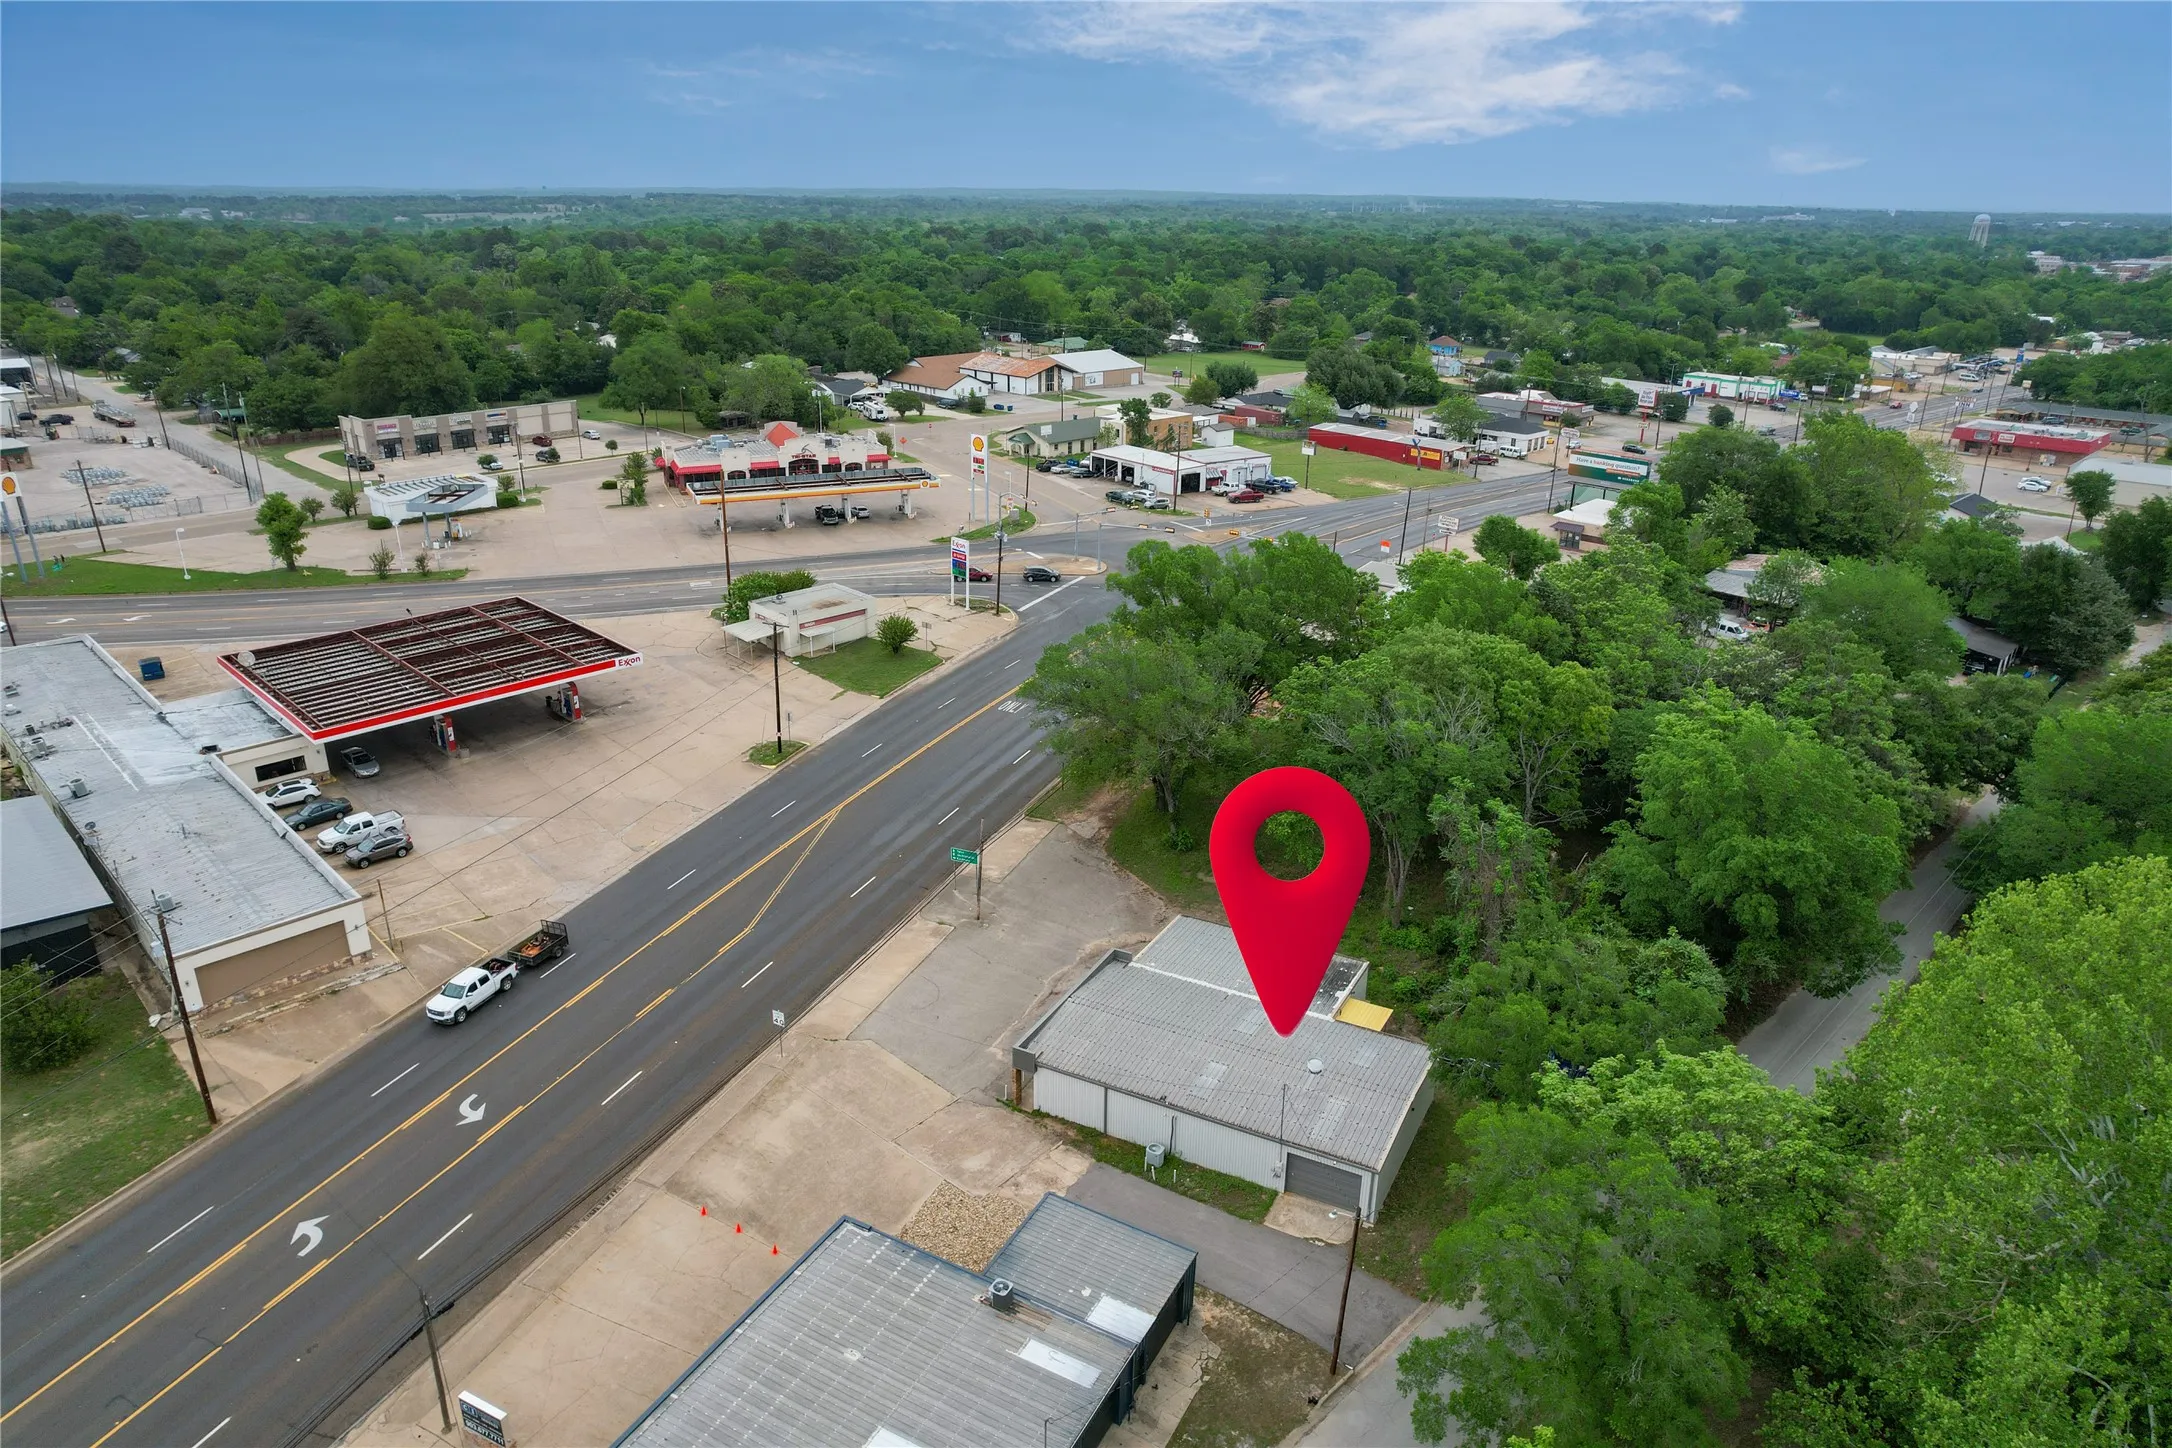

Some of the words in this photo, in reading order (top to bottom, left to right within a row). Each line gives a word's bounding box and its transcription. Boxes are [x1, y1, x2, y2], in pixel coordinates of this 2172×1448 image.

[1593, 460, 1615, 468] banking
[1615, 463, 1641, 471] question?
[952, 540, 966, 549] Exxon
[618, 656, 641, 667] Exxon
[998, 700, 1030, 714] ONLY
